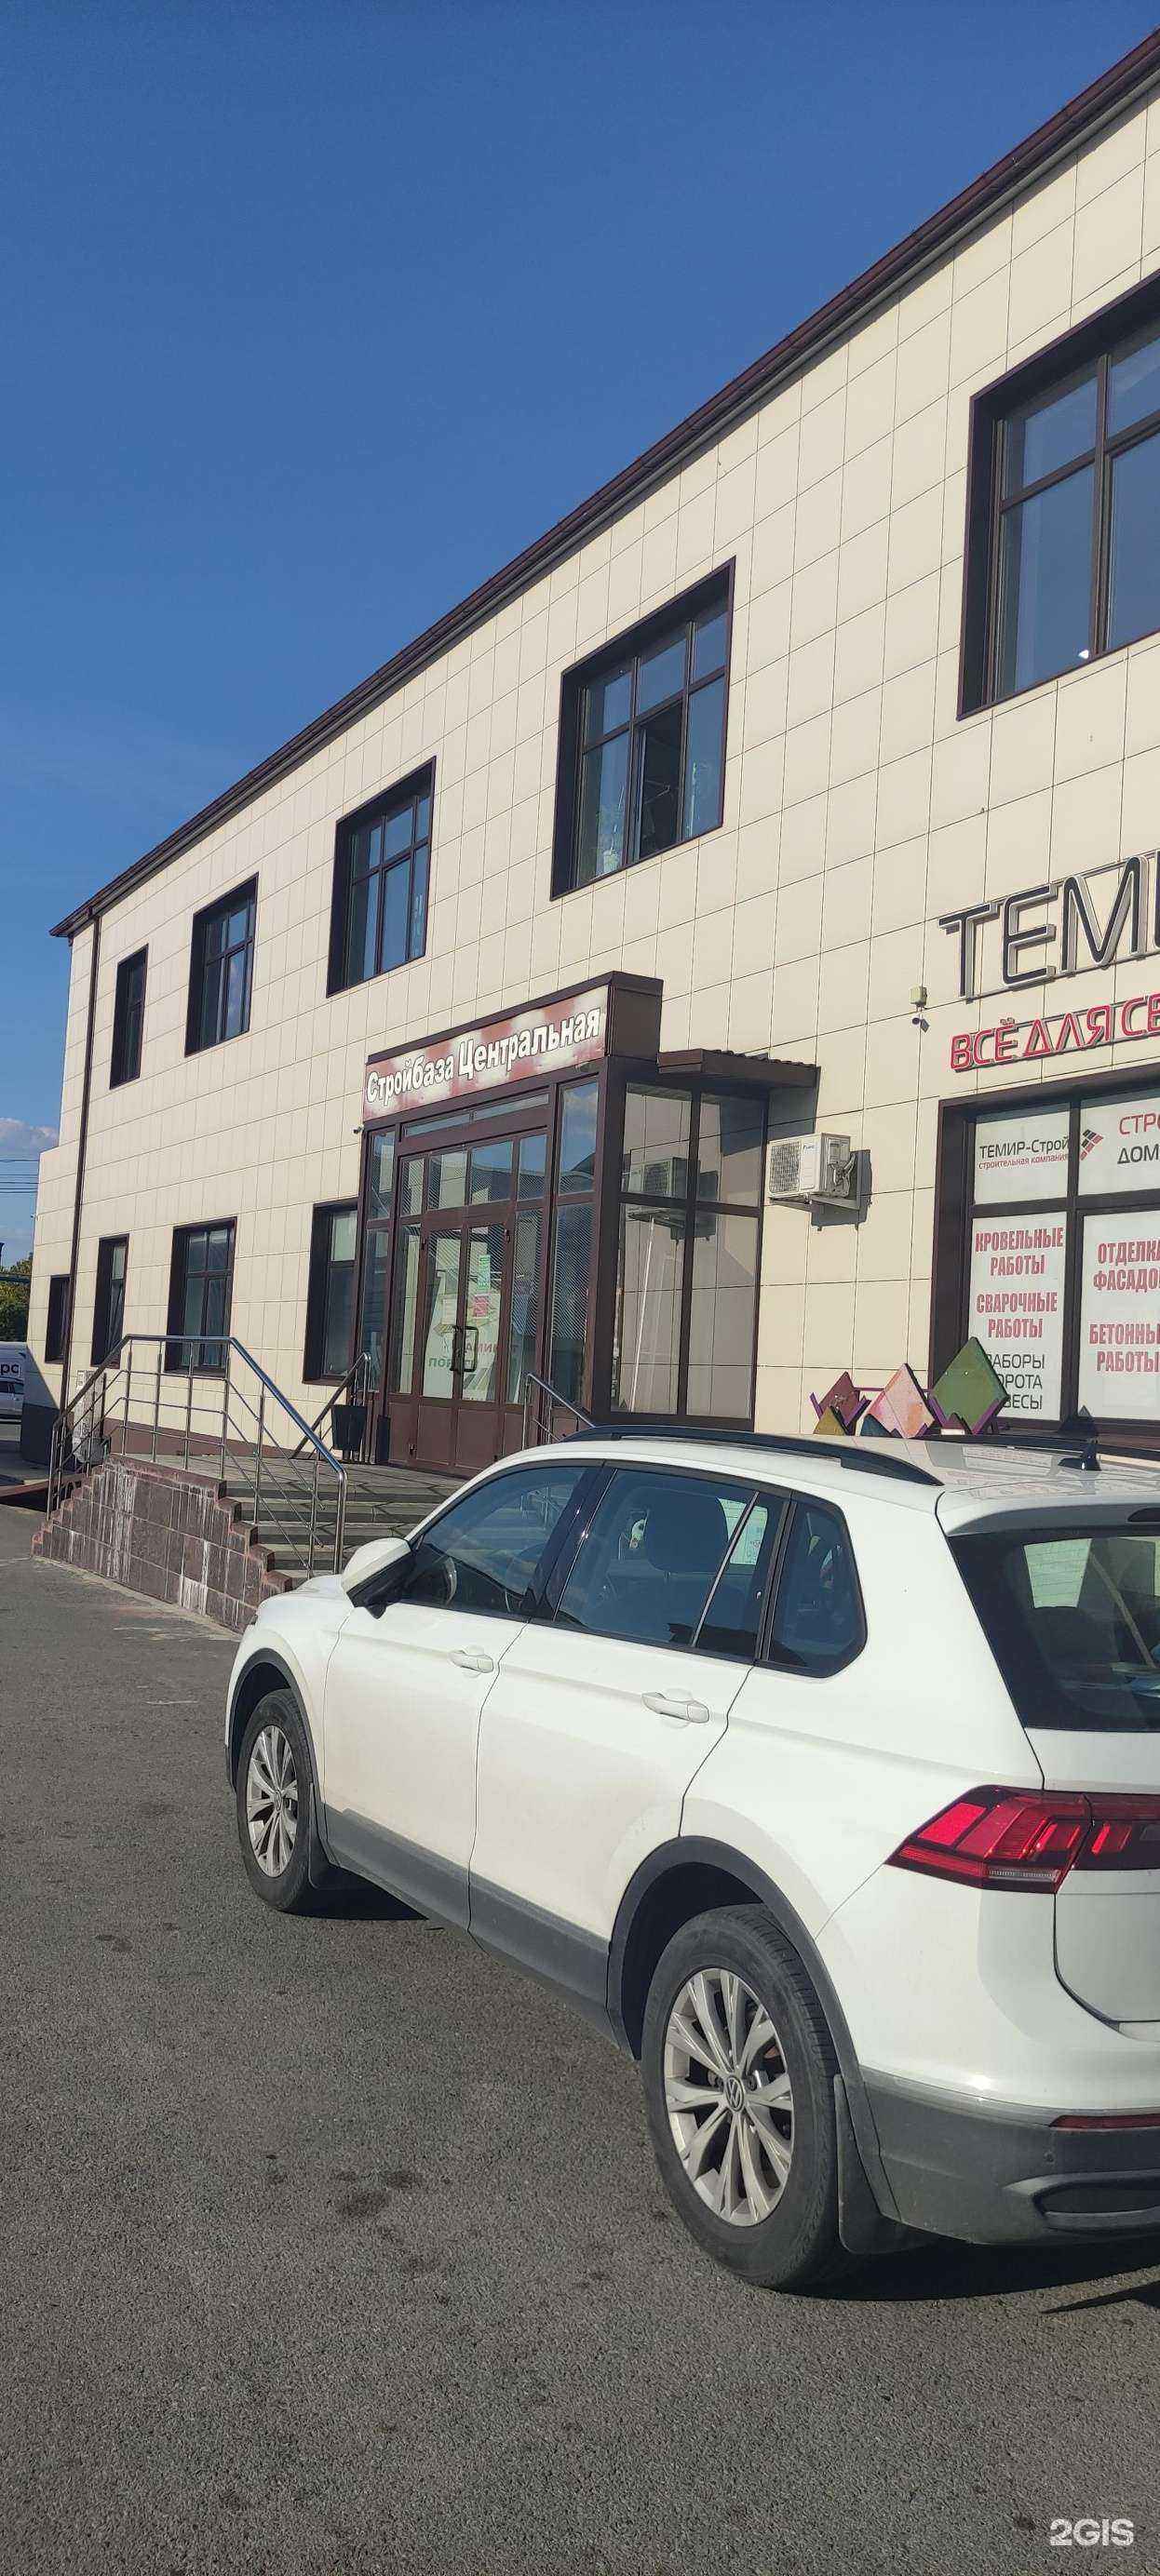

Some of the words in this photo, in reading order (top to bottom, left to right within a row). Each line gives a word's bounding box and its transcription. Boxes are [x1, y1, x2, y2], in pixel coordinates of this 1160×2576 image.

[938, 849, 1160, 1002] ТЕМ
[950, 1017, 1018, 1071] ВСЁ
[1023, 1004, 1112, 1058] ДЛЯ
[367, 1054, 454, 1106] Стройбаза
[458, 1007, 601, 1080] Центральная
[1120, 1112, 1160, 1134] СТР
[979, 1135, 1070, 1159] ТЕМИР-Строй
[978, 1157, 1030, 1170] строительная
[976, 1227, 1063, 1252] КРОВЕЛЬНЫЕ
[991, 1254, 1045, 1276] РАБОТЫ
[1093, 1267, 1160, 1292] ФАСАДО
[977, 1292, 1058, 1313] СВАРОЧНЫЕ
[988, 1318, 1043, 1338] РАБОТЫ
[1097, 1350, 1159, 1373] РАБОТЫ
